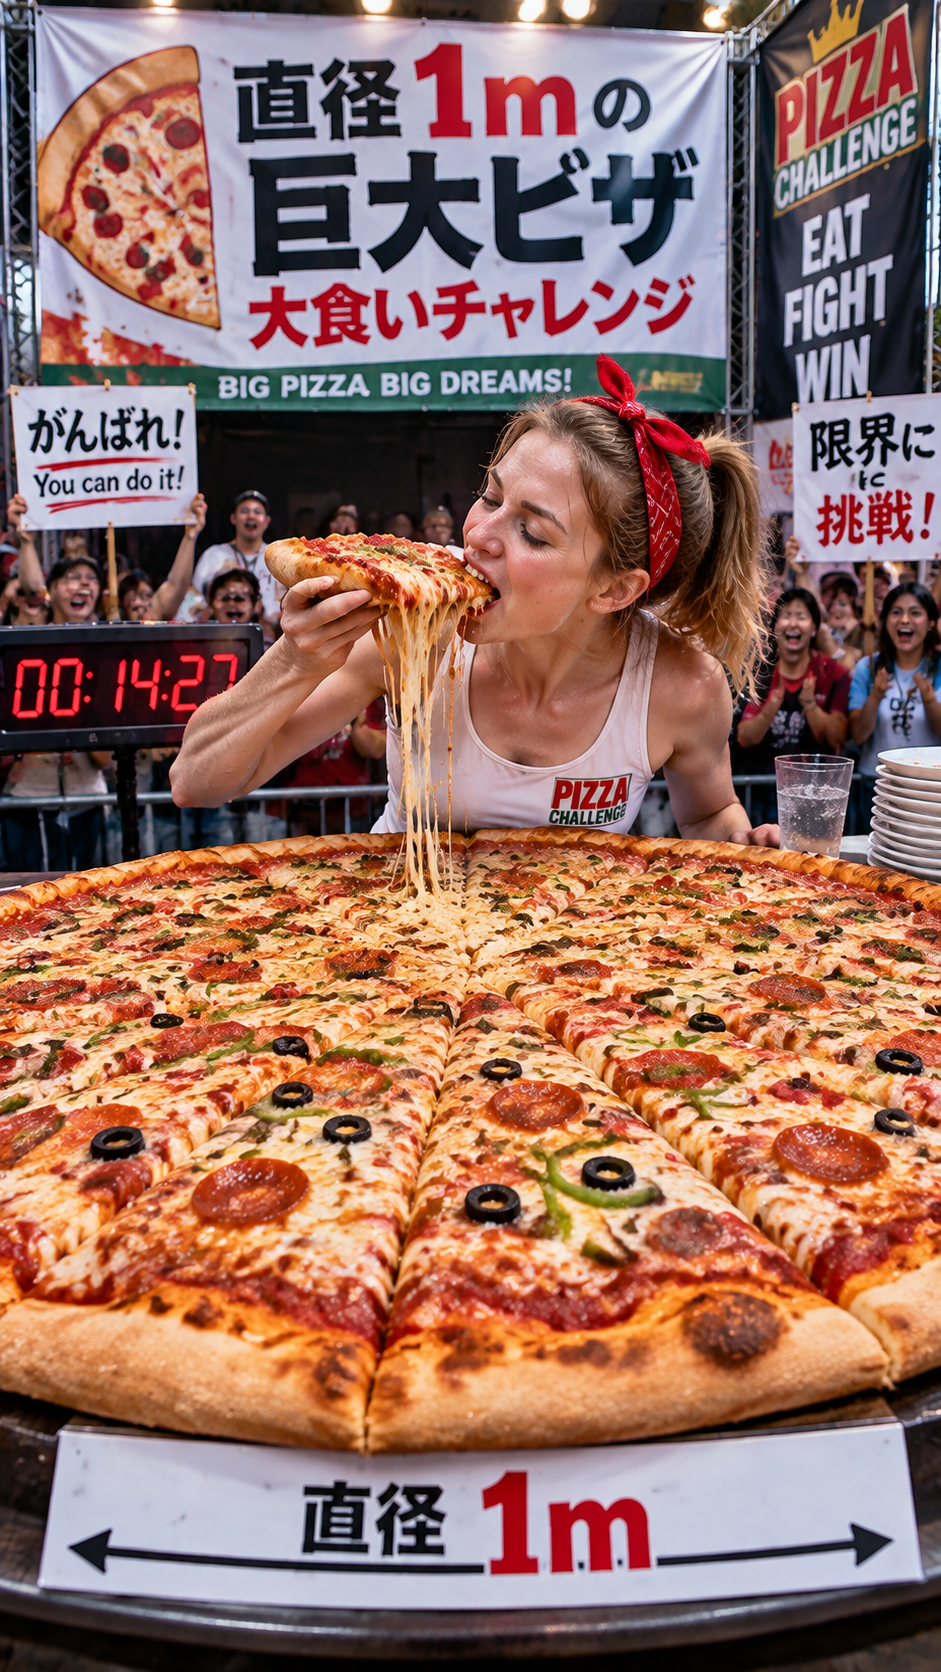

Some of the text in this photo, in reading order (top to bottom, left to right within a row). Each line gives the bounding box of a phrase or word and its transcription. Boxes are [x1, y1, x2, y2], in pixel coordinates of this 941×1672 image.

[776, 9, 916, 167] PIZZA
[774, 98, 917, 210] CHALLENGE
[802, 193, 871, 277] EAT
[249, 275, 695, 350] 大食いチャレンジ
[783, 253, 894, 348] FIGHT
[218, 368, 573, 399] BIG PIZZA BIG DREAMS!
[795, 334, 871, 403] WIN
[28, 406, 185, 453] がんばれ!
[810, 412, 935, 472] 限界に
[34, 465, 185, 498] You can do it!
[816, 489, 935, 548] 挑戦!
[551, 777, 628, 810] PIZZA
